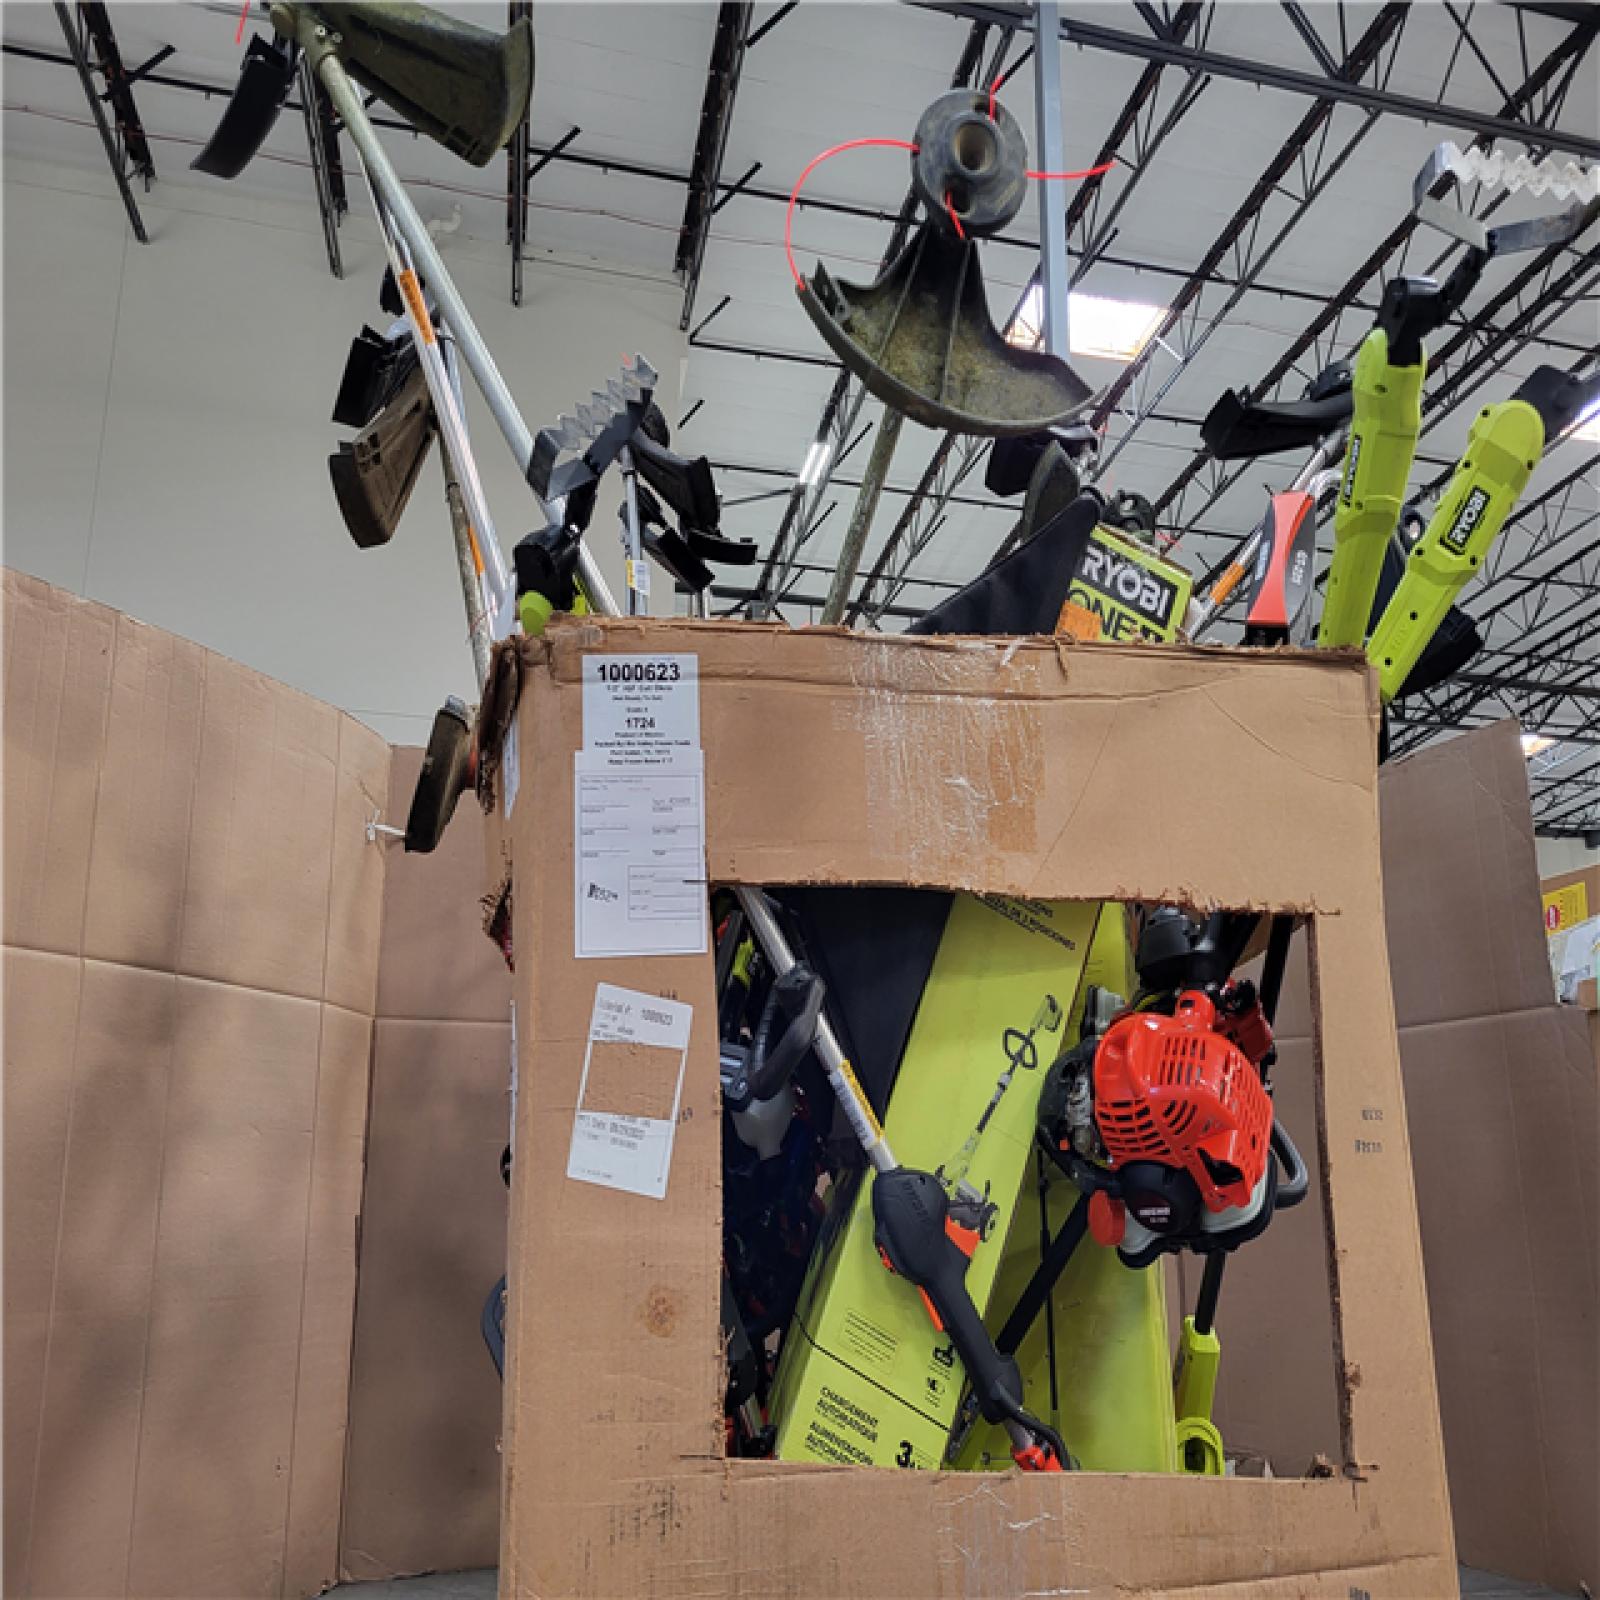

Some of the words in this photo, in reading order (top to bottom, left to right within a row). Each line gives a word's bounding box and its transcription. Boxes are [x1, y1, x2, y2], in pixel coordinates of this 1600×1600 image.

[1450, 489, 1486, 543] RYOBI
[1082, 544, 1171, 618] RYOBI
[597, 663, 681, 681] 1000623
